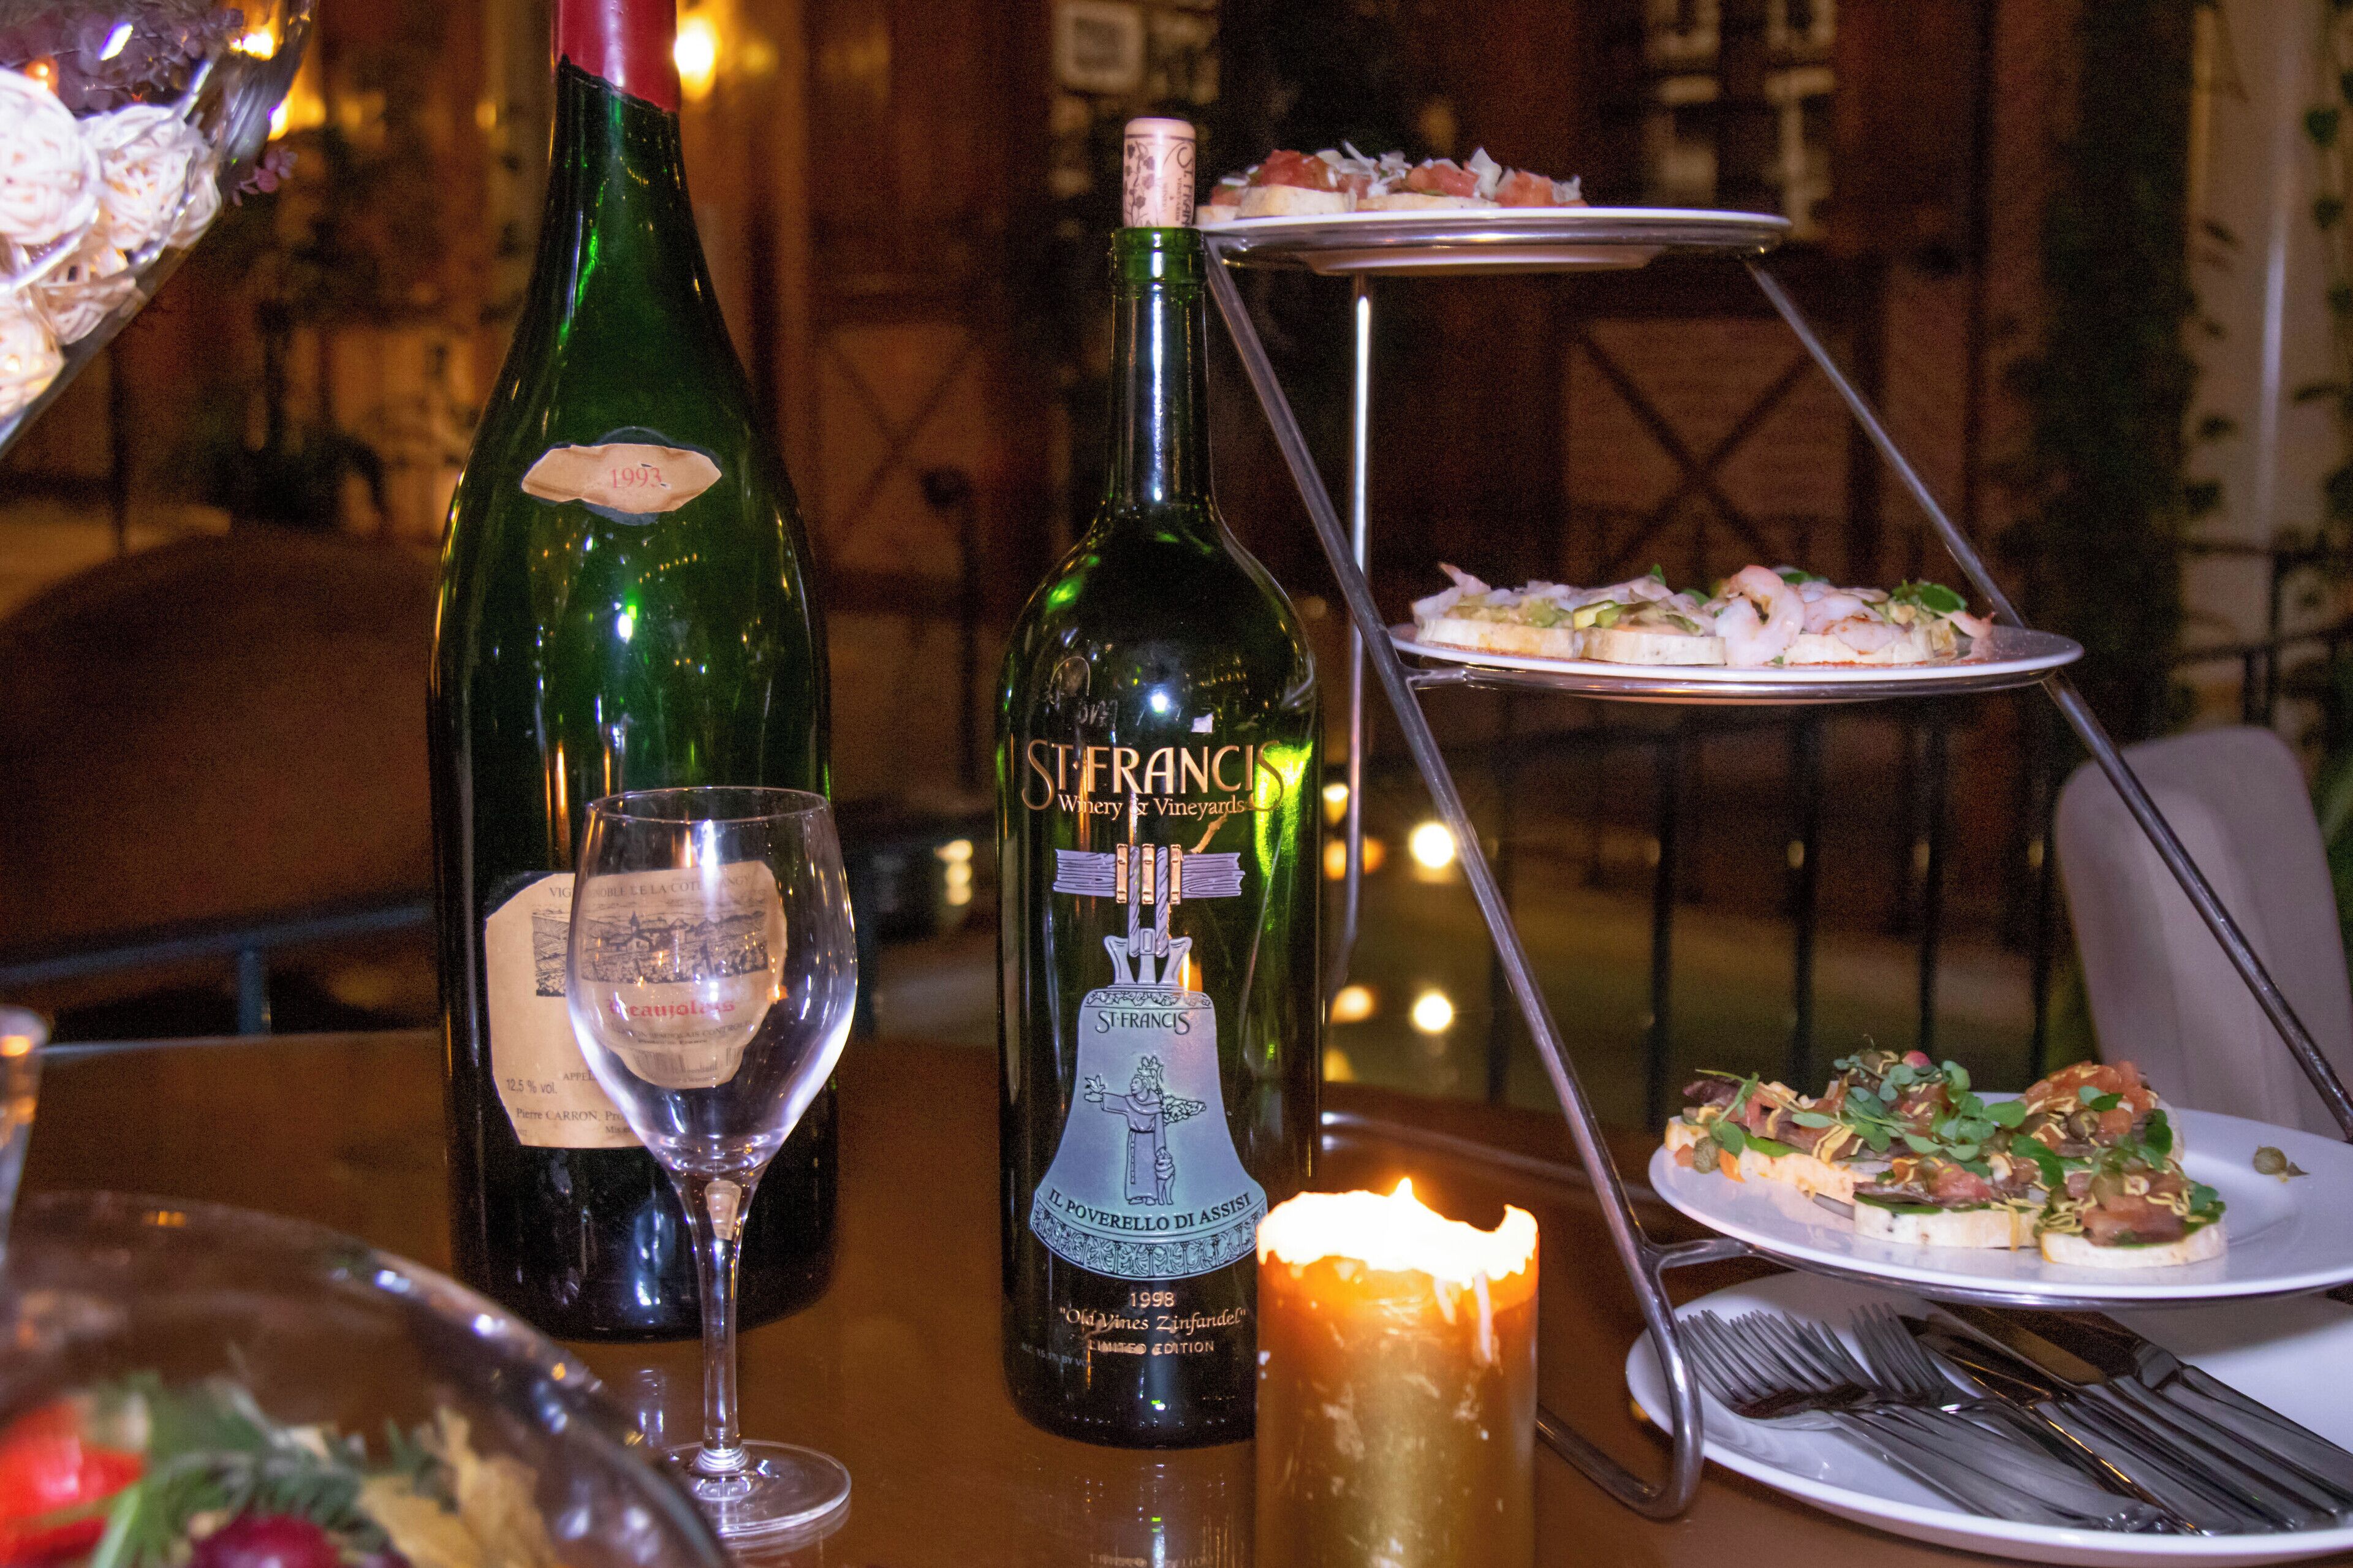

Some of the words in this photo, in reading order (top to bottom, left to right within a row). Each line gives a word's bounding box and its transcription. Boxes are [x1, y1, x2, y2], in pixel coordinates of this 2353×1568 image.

[610, 467, 662, 489] 1993
[1058, 794, 1123, 820] Winery
[1131, 797, 1149, 816] &
[1152, 795, 1245, 821] Vineyards
[528, 1080, 537, 1093] %
[540, 1081, 558, 1094] vol.
[517, 1108, 542, 1120] Pierre
[1048, 1187, 1063, 1208] IL
[1065, 1199, 1170, 1231] POVERELLO
[1174, 1213, 1195, 1229] DI
[1199, 1192, 1251, 1225] ASSISI
[1131, 1292, 1176, 1309] 1998
[1099, 1312, 1150, 1330] Vines
[1156, 1307, 1246, 1336] Zinfandel"
[1151, 1340, 1214, 1356] EDITION
